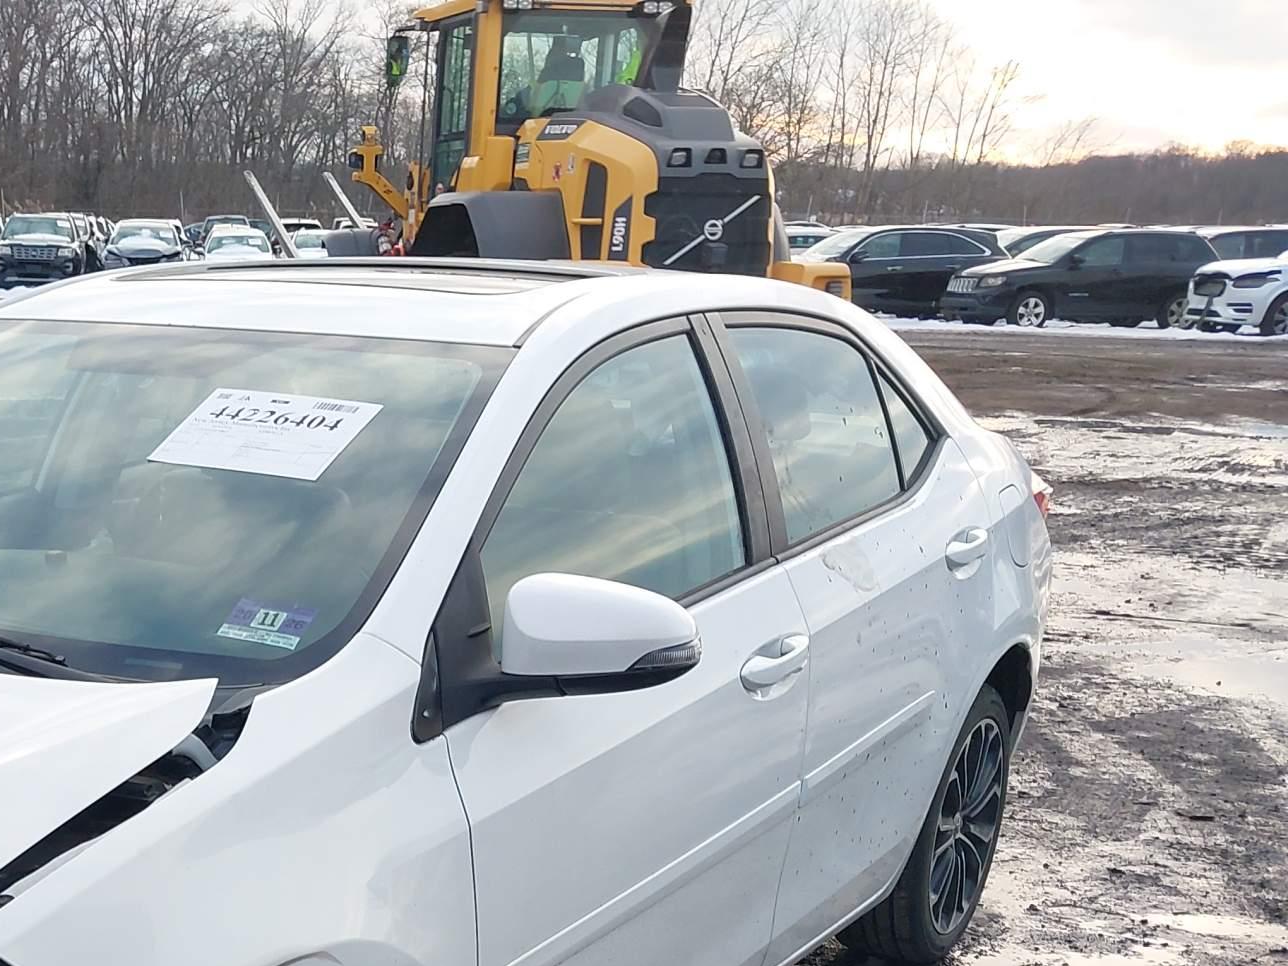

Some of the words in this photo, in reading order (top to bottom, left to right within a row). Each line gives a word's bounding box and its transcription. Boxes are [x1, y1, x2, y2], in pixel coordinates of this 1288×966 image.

[610, 216, 628, 252] L90H
[209, 405, 345, 432] 44226404
[258, 611, 280, 627] 11
